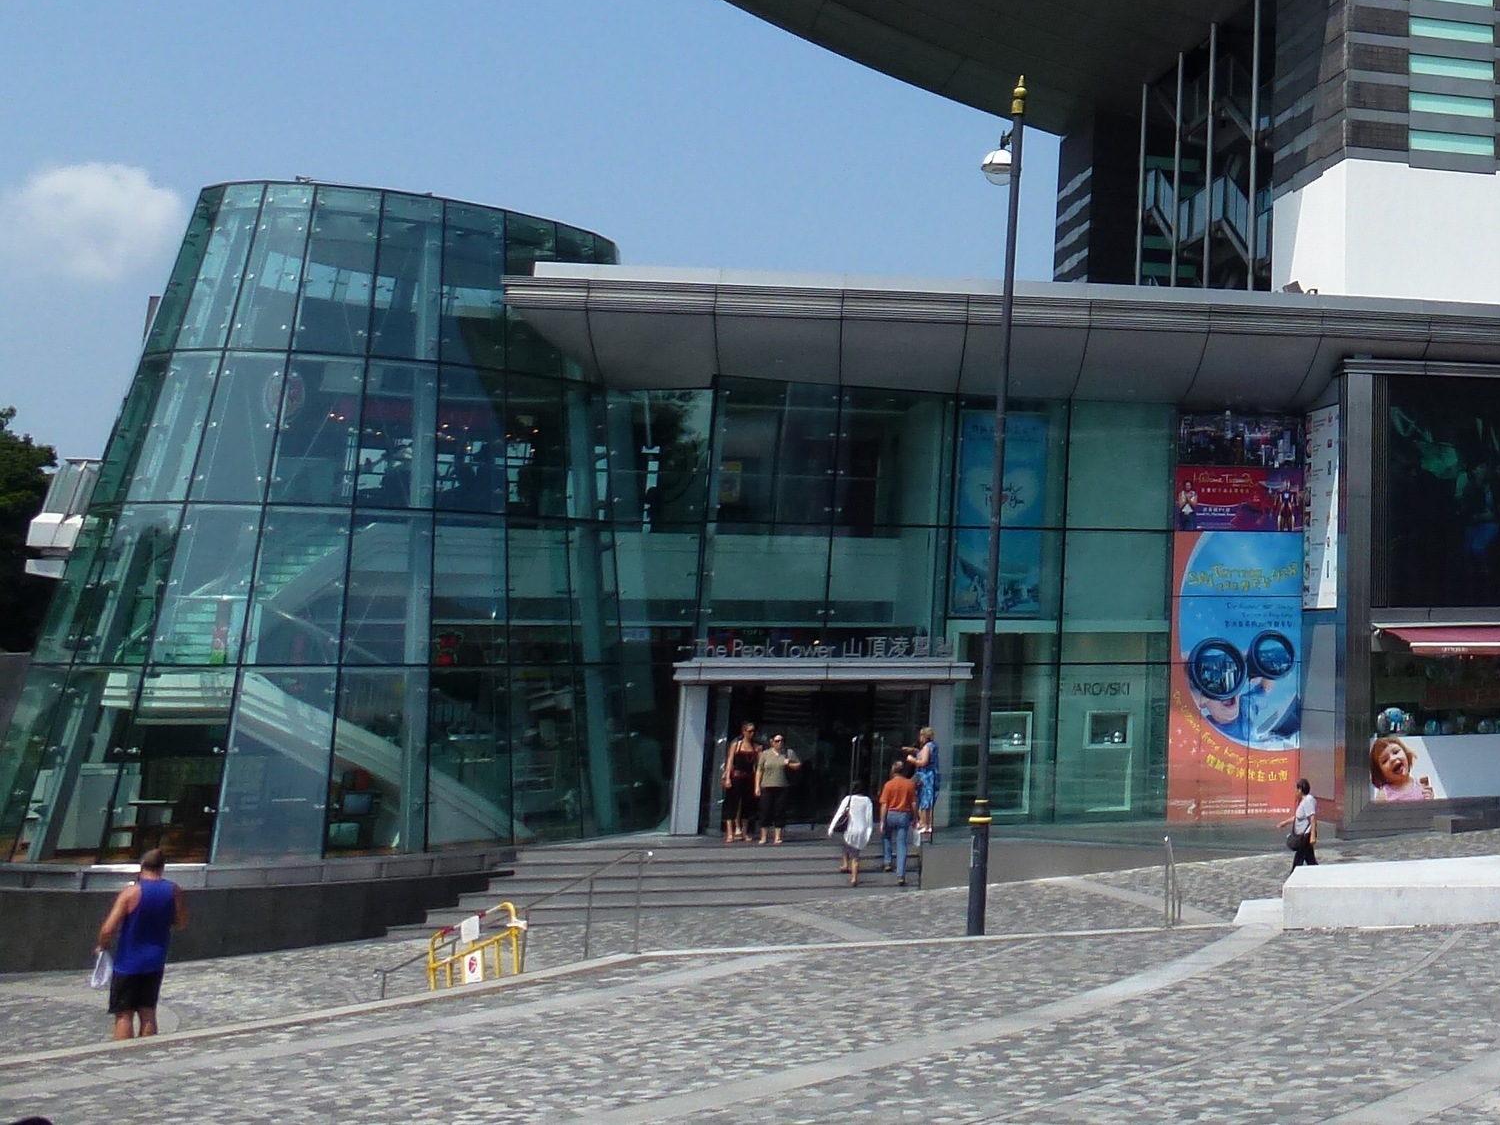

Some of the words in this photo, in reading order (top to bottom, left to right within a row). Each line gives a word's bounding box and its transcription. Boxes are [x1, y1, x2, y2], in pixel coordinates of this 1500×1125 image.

[694, 639, 727, 658] The
[732, 639, 774, 658] Peak
[780, 639, 836, 658] Tower
